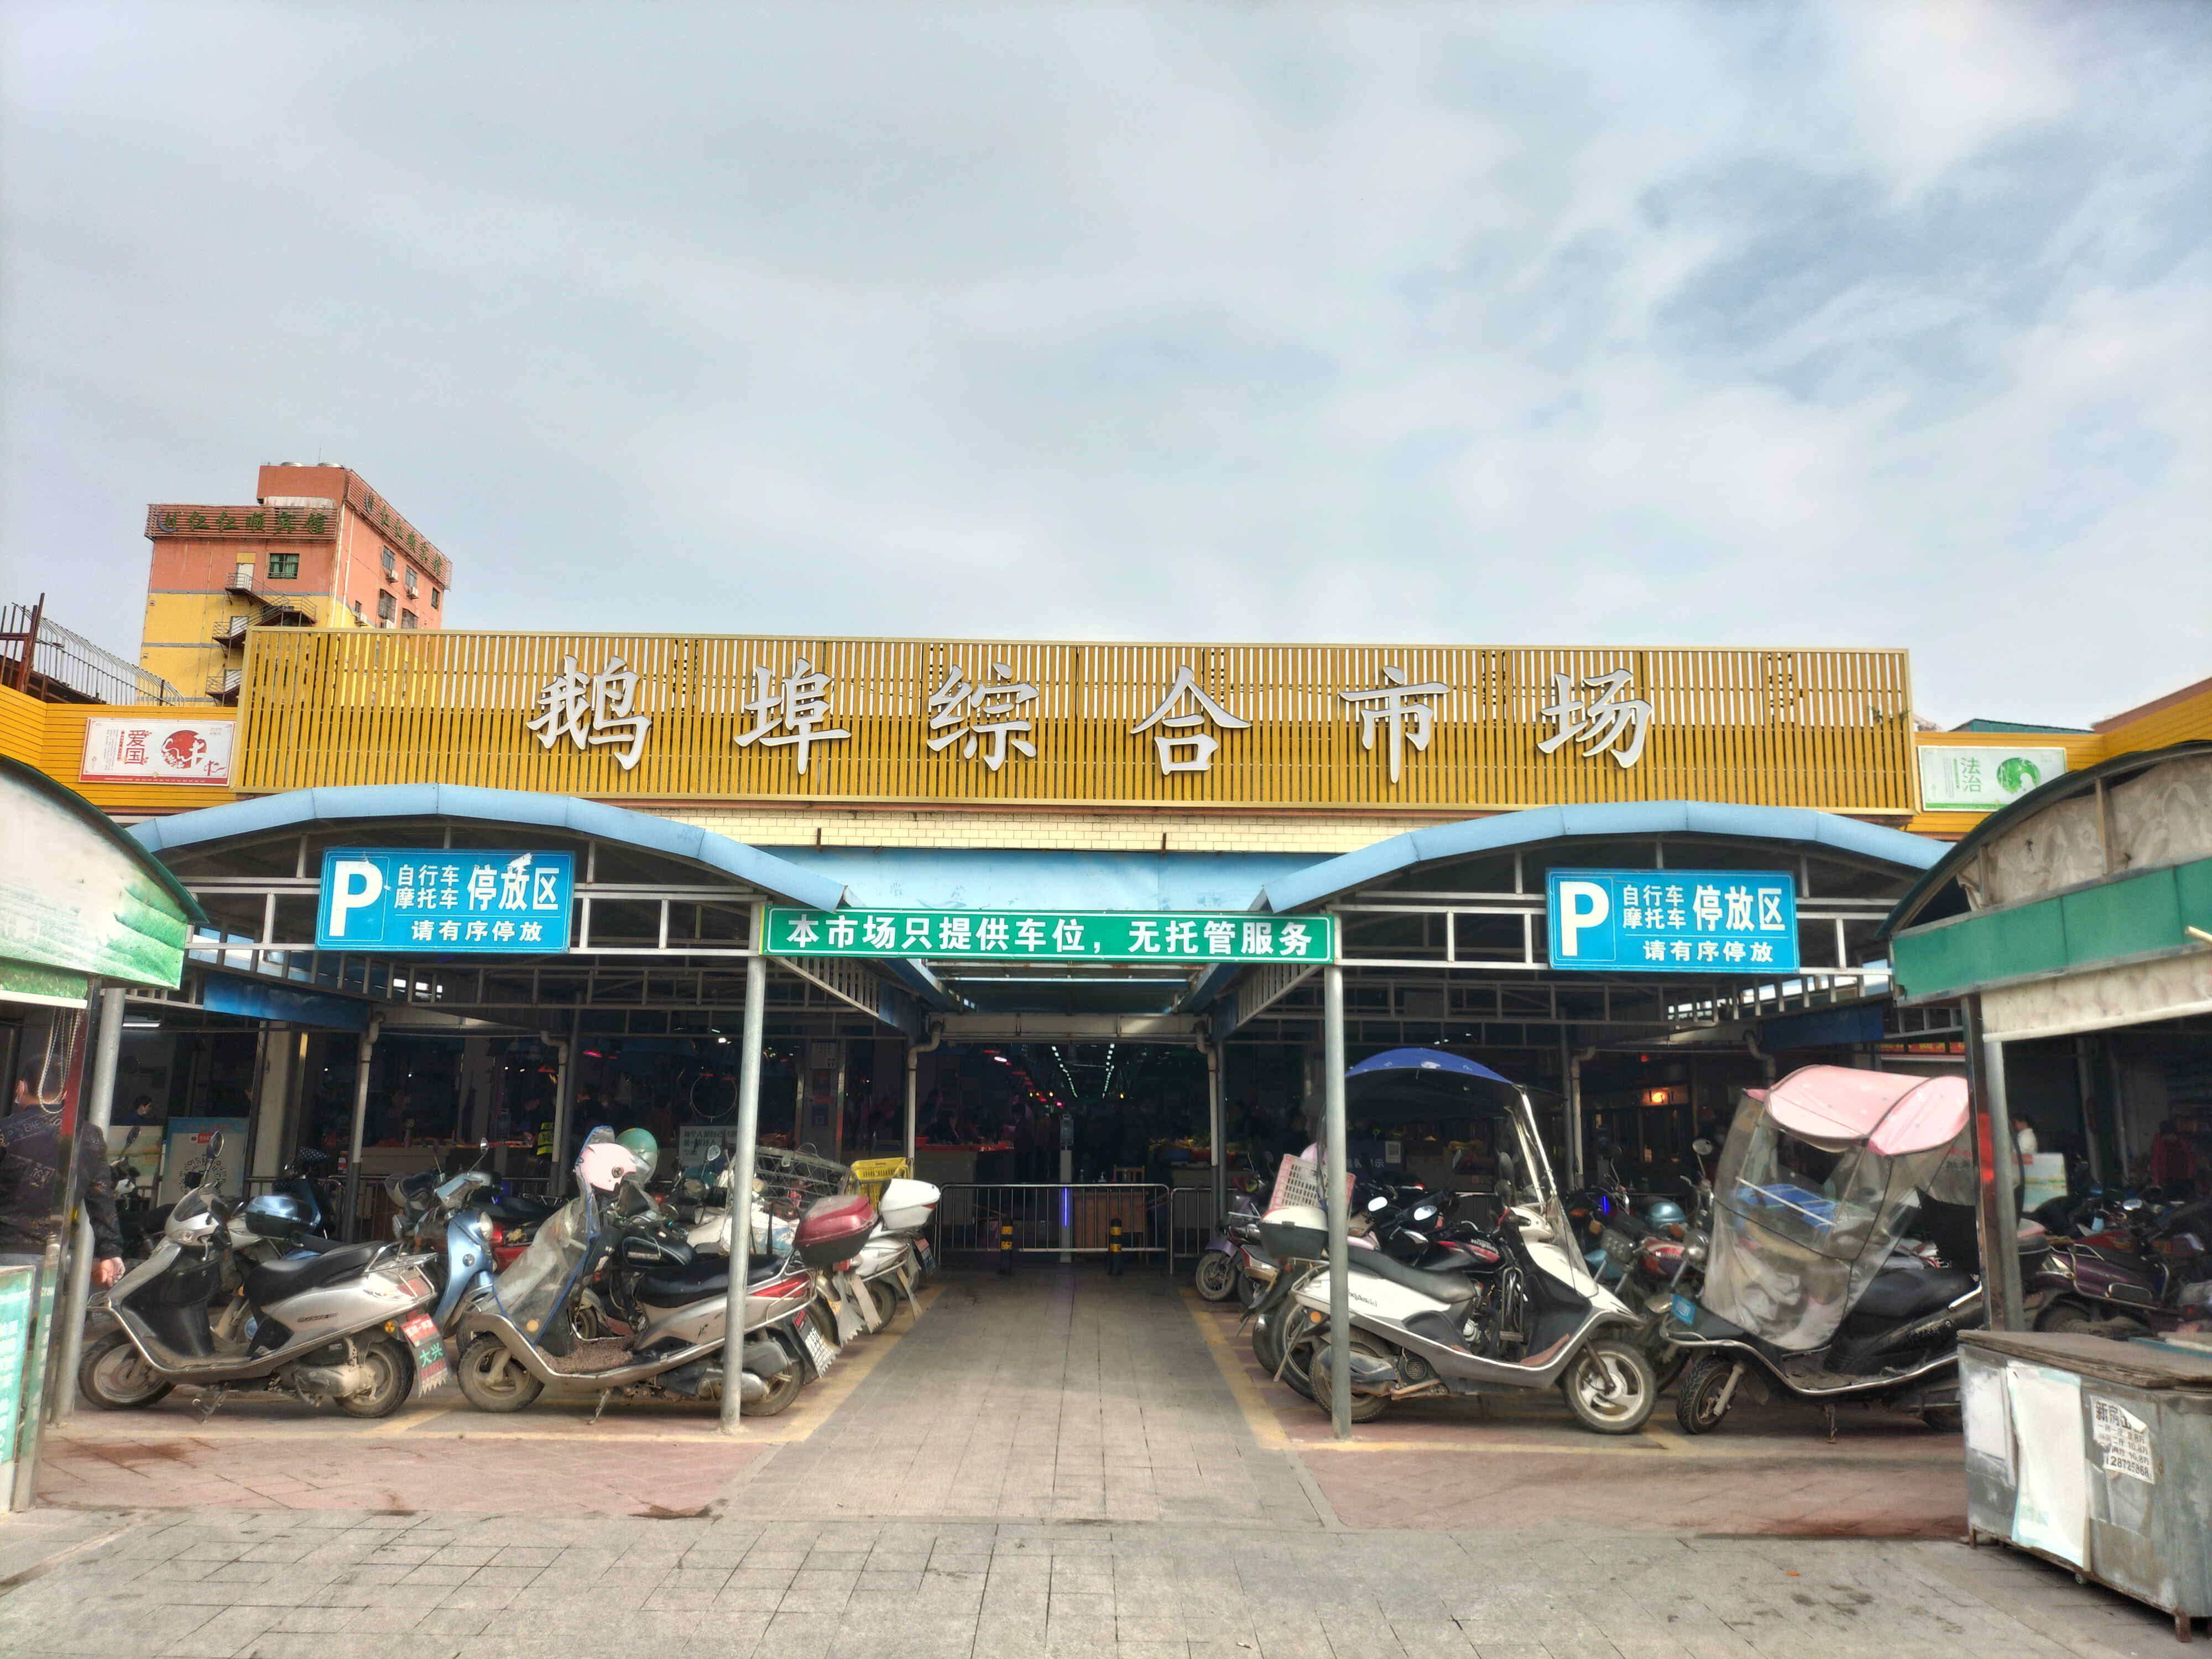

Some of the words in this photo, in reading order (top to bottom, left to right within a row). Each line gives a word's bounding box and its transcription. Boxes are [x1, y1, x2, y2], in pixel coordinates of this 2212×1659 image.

[526, 654, 1652, 783] 鹅埠综合市场
[124, 729, 148, 765] 爱国
[1960, 757, 1982, 793] 法治
[398, 864, 460, 886] 自行车
[467, 864, 560, 911] 停放区
[328, 860, 383, 936] P
[394, 888, 460, 910] 摩托车
[1623, 884, 1685, 906] 自行车
[1692, 885, 1786, 931] 停放区
[411, 920, 544, 942] 请有序停放
[1559, 881, 1609, 957] P
[1623, 907, 1687, 930] 摩托车
[1642, 940, 1773, 962] 请有序停放
[419, 1342, 444, 1368] 大兴
